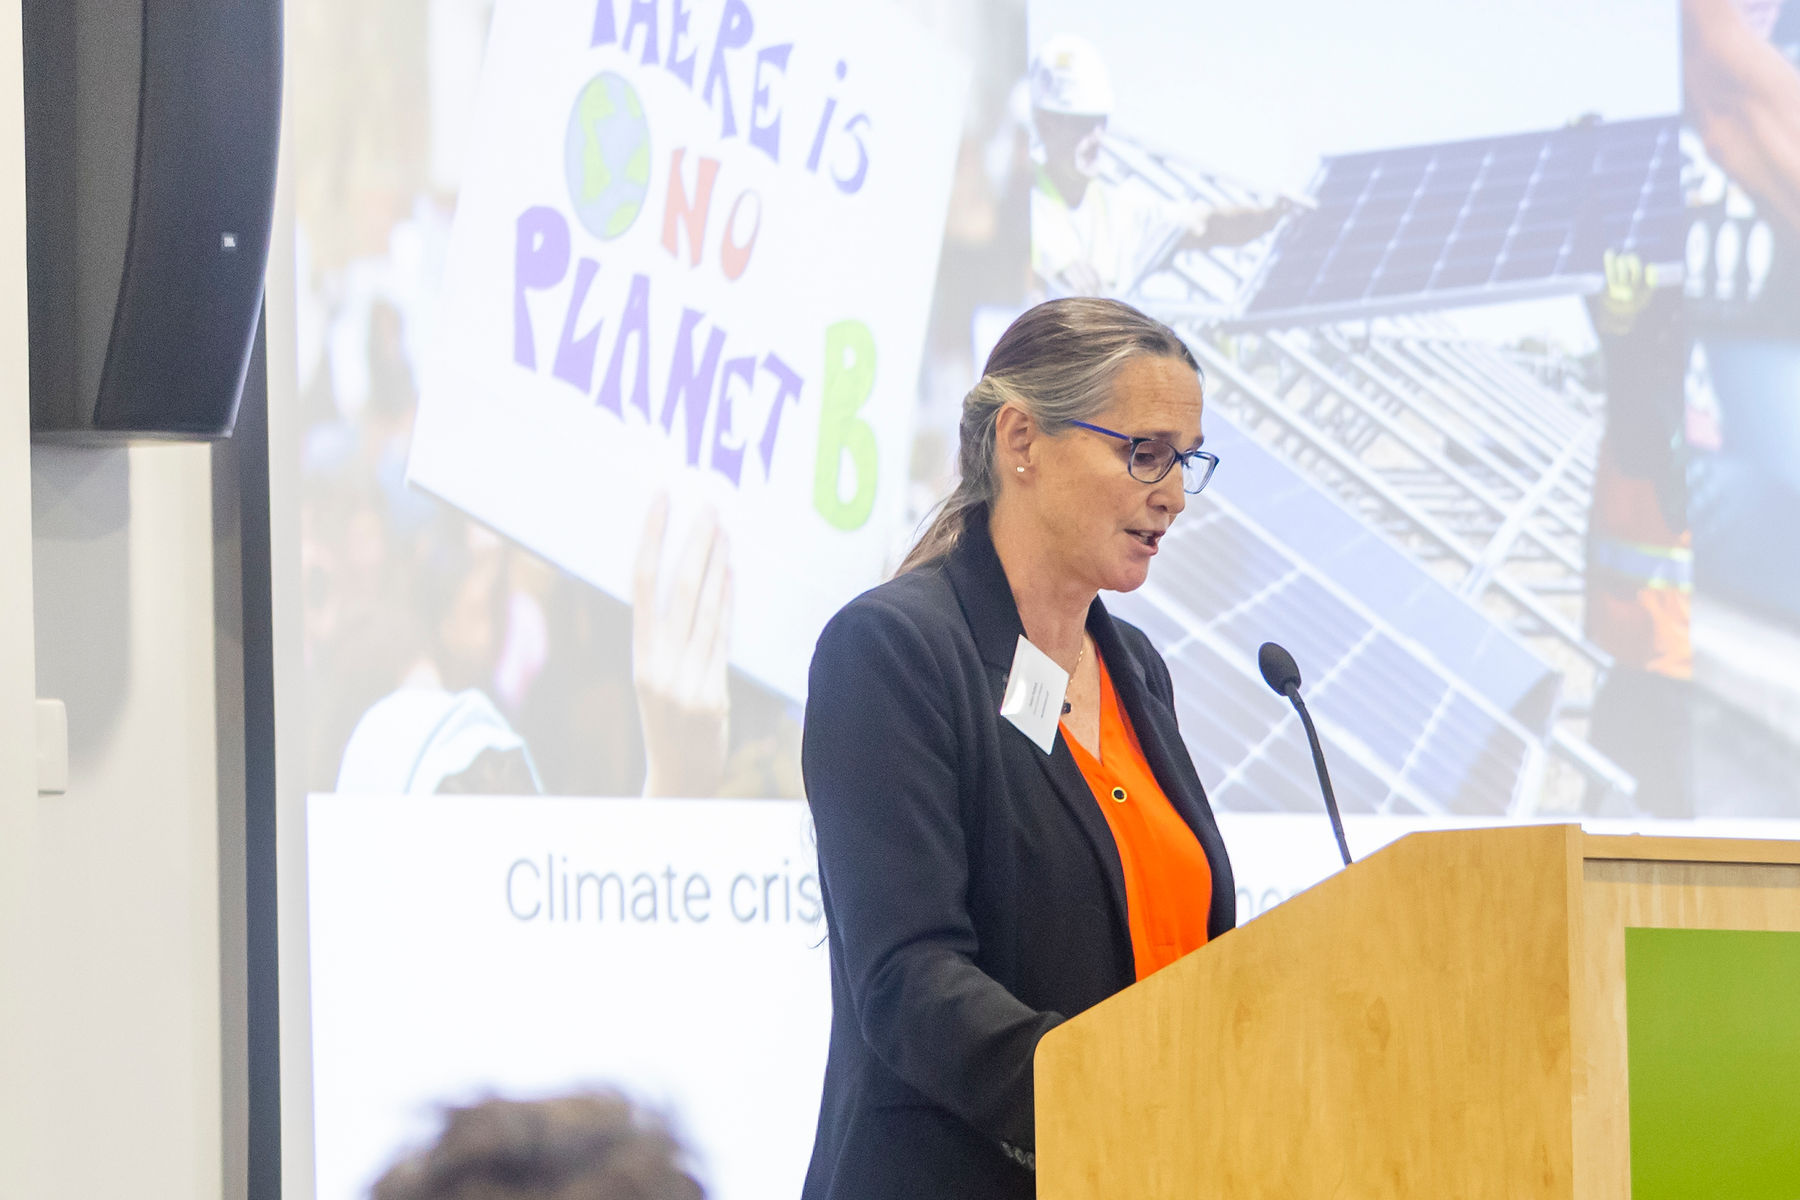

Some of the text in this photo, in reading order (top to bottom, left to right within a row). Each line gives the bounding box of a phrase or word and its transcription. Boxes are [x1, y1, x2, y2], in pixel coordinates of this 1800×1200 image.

[661, 146, 761, 282] NO
[513, 205, 878, 532] PLANET B
[506, 853, 711, 922] Climate
